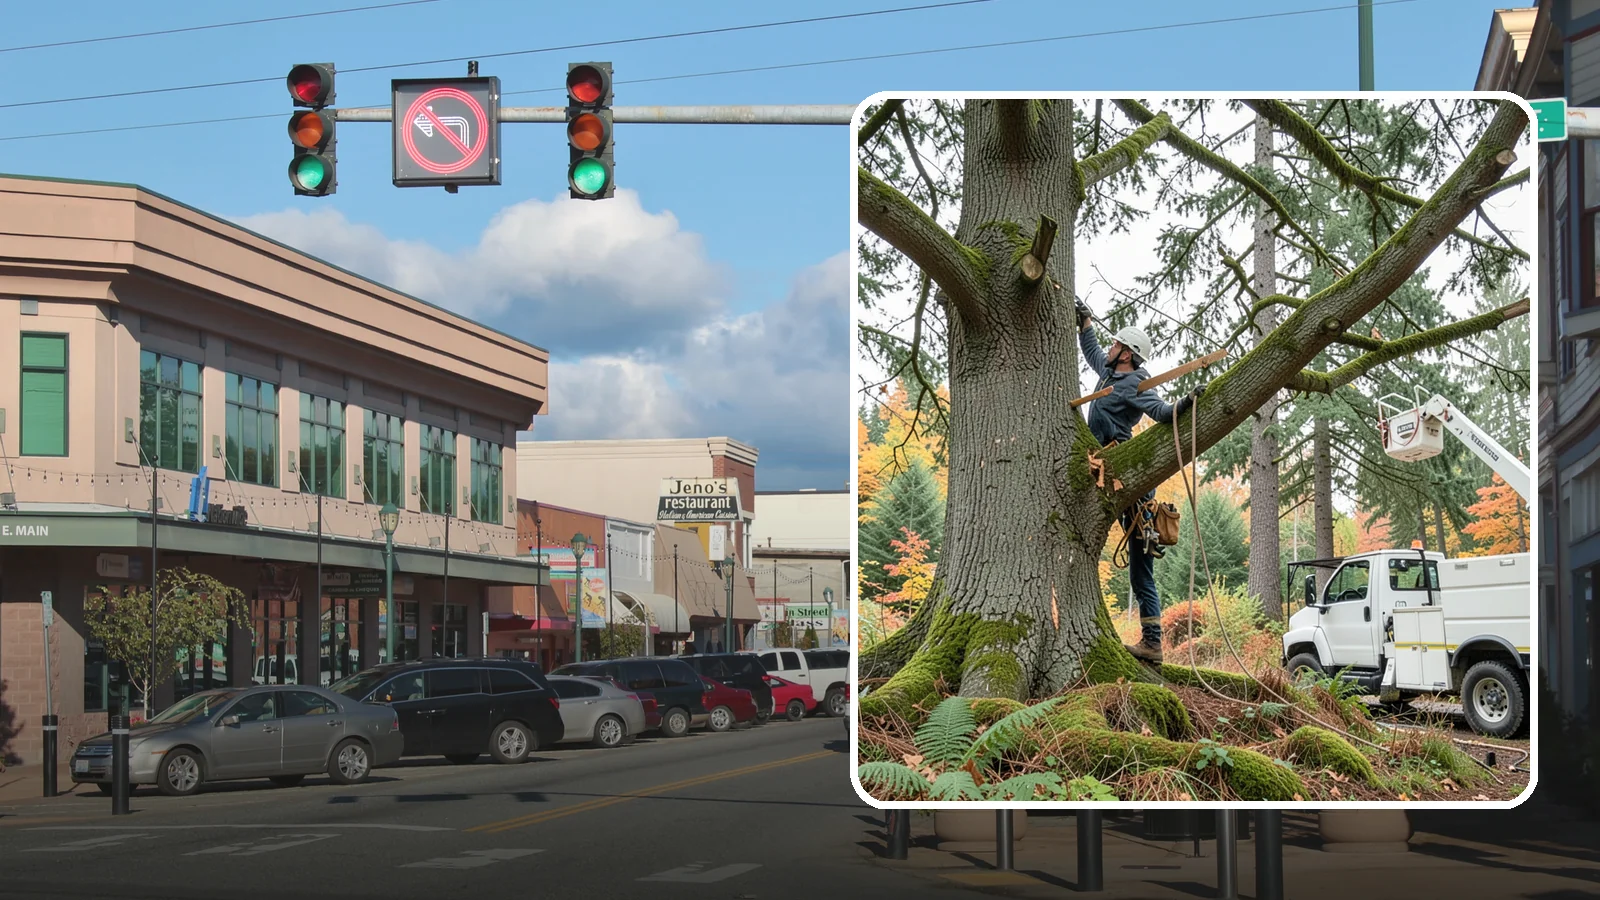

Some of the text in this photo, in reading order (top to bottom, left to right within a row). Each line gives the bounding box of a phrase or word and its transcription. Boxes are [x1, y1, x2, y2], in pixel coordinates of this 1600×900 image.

[669, 480, 728, 495] Jeno's
[665, 496, 731, 509] restaurant
[686, 509, 715, 519] American
[715, 509, 738, 519] Cuisine
[2, 525, 49, 536] E. MAIN
[797, 607, 828, 617] Street
